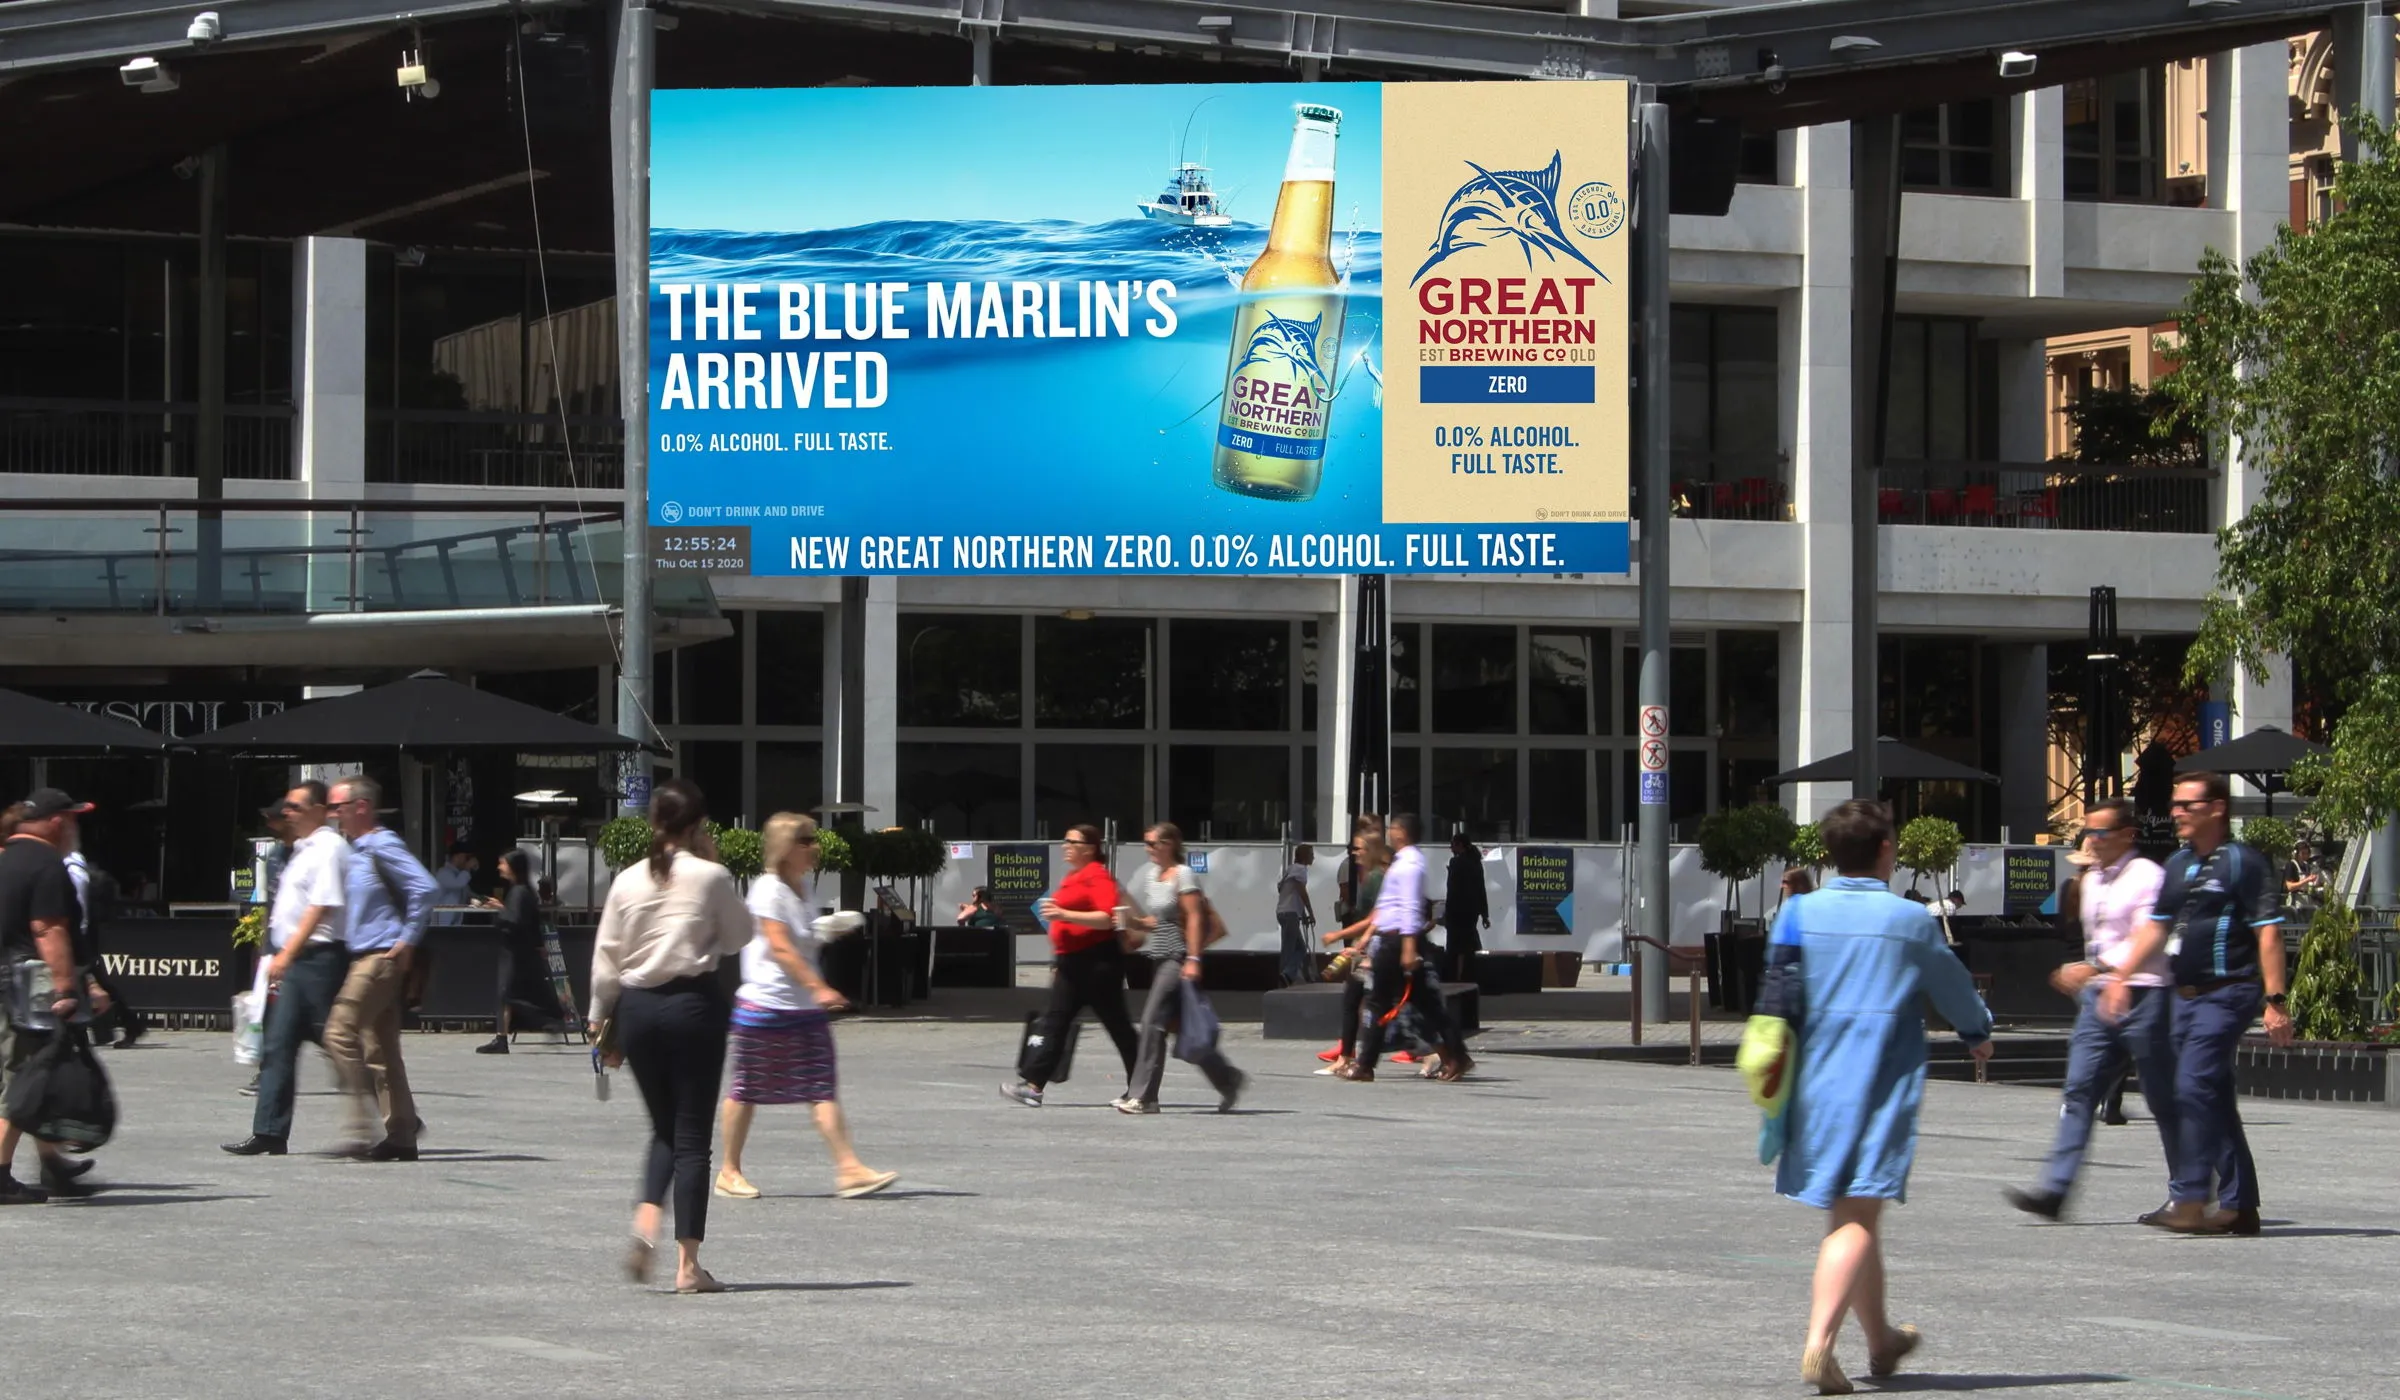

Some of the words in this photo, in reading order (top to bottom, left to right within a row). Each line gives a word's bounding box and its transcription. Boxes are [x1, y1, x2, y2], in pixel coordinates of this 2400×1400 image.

[1419, 277, 1595, 315] GREAT
[659, 283, 762, 340] THE
[779, 282, 909, 340] BLUE
[927, 279, 1178, 338] MARLIN'S
[1419, 319, 1596, 345] NORTHERN
[1420, 348, 1445, 362] EST
[1450, 348, 1538, 362] BREWING
[1570, 348, 1596, 363] QLD
[660, 351, 888, 409] ARRIVED
[1488, 376, 1527, 393] ZERO
[1233, 376, 1325, 409] GREAT
[1229, 399, 1322, 427] NORTHERN
[1240, 419, 1292, 435] BREWING
[660, 433, 704, 452] 0.0%
[709, 433, 789, 452] ALCOHOL.
[794, 432, 834, 451] FULL
[839, 431, 893, 451] TASTE.
[1231, 433, 1253, 449] ZERO
[1275, 442, 1294, 455] FULL
[1295, 444, 1318, 456] TASTE
[1435, 426, 1484, 447] 0.0%
[1490, 426, 1580, 447] ALCOHOL.
[1452, 453, 1496, 474] FULL
[1502, 453, 1564, 474] TASTE.
[688, 506, 722, 518] DON'T
[725, 506, 761, 517] DRINK
[764, 506, 788, 517] AND
[791, 505, 825, 517] DRIVE
[664, 537, 737, 551] 12:55:24
[791, 536, 850, 569] NEW
[860, 536, 944, 569] GREAT
[953, 535, 1093, 568] NORTHERN
[1104, 535, 1180, 568] ZERO.
[1190, 534, 1258, 568] 0.0%
[1268, 534, 1395, 567] ALCOHOL.
[1406, 534, 1469, 566] FULL
[1478, 533, 1564, 566] TASTE.
[656, 558, 676, 568] Thu
[679, 558, 697, 569] Oct
[701, 558, 714, 568] 15
[717, 558, 744, 569] 2020
[994, 853, 1042, 864] Brisbane
[1522, 856, 1568, 866] Brisbane
[2009, 856, 2050, 867] Brisbane
[994, 867, 1040, 880] Building
[1523, 869, 1565, 881] Building
[2009, 869, 2048, 881] Building
[994, 878, 1042, 889] Services
[1523, 880, 1567, 890] Services
[2009, 880, 2049, 890] Services
[100, 954, 220, 977] WHISTLE
